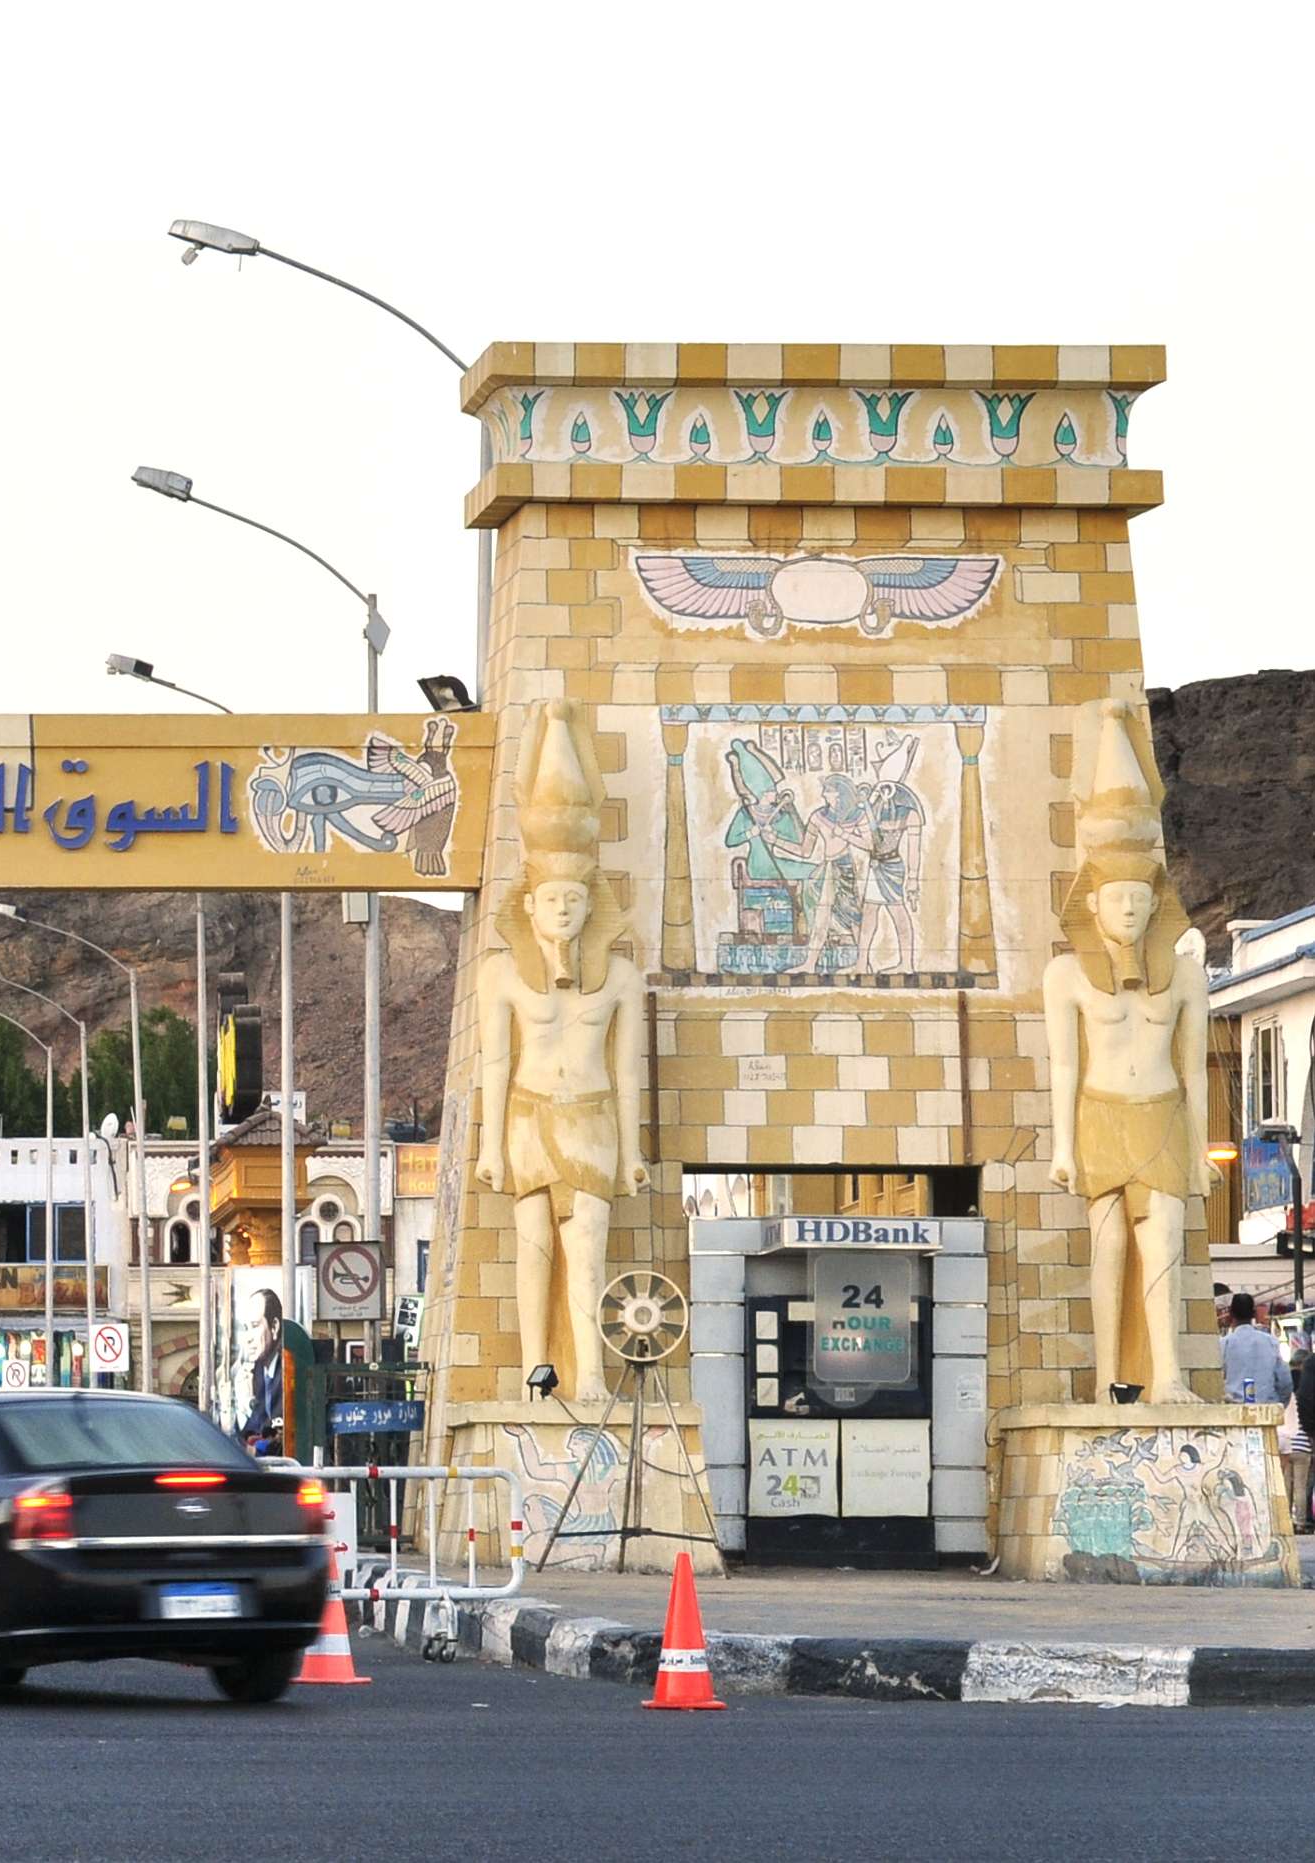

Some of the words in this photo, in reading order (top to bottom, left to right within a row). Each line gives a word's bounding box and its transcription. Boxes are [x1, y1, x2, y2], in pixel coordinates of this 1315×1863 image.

[46, 758, 238, 852] السوق
[796, 1219, 931, 1244] HDBank
[841, 1284, 885, 1309] 24
[758, 1447, 829, 1467] ATM
[766, 1474, 799, 1497] 24
[771, 1497, 801, 1508] Cash
